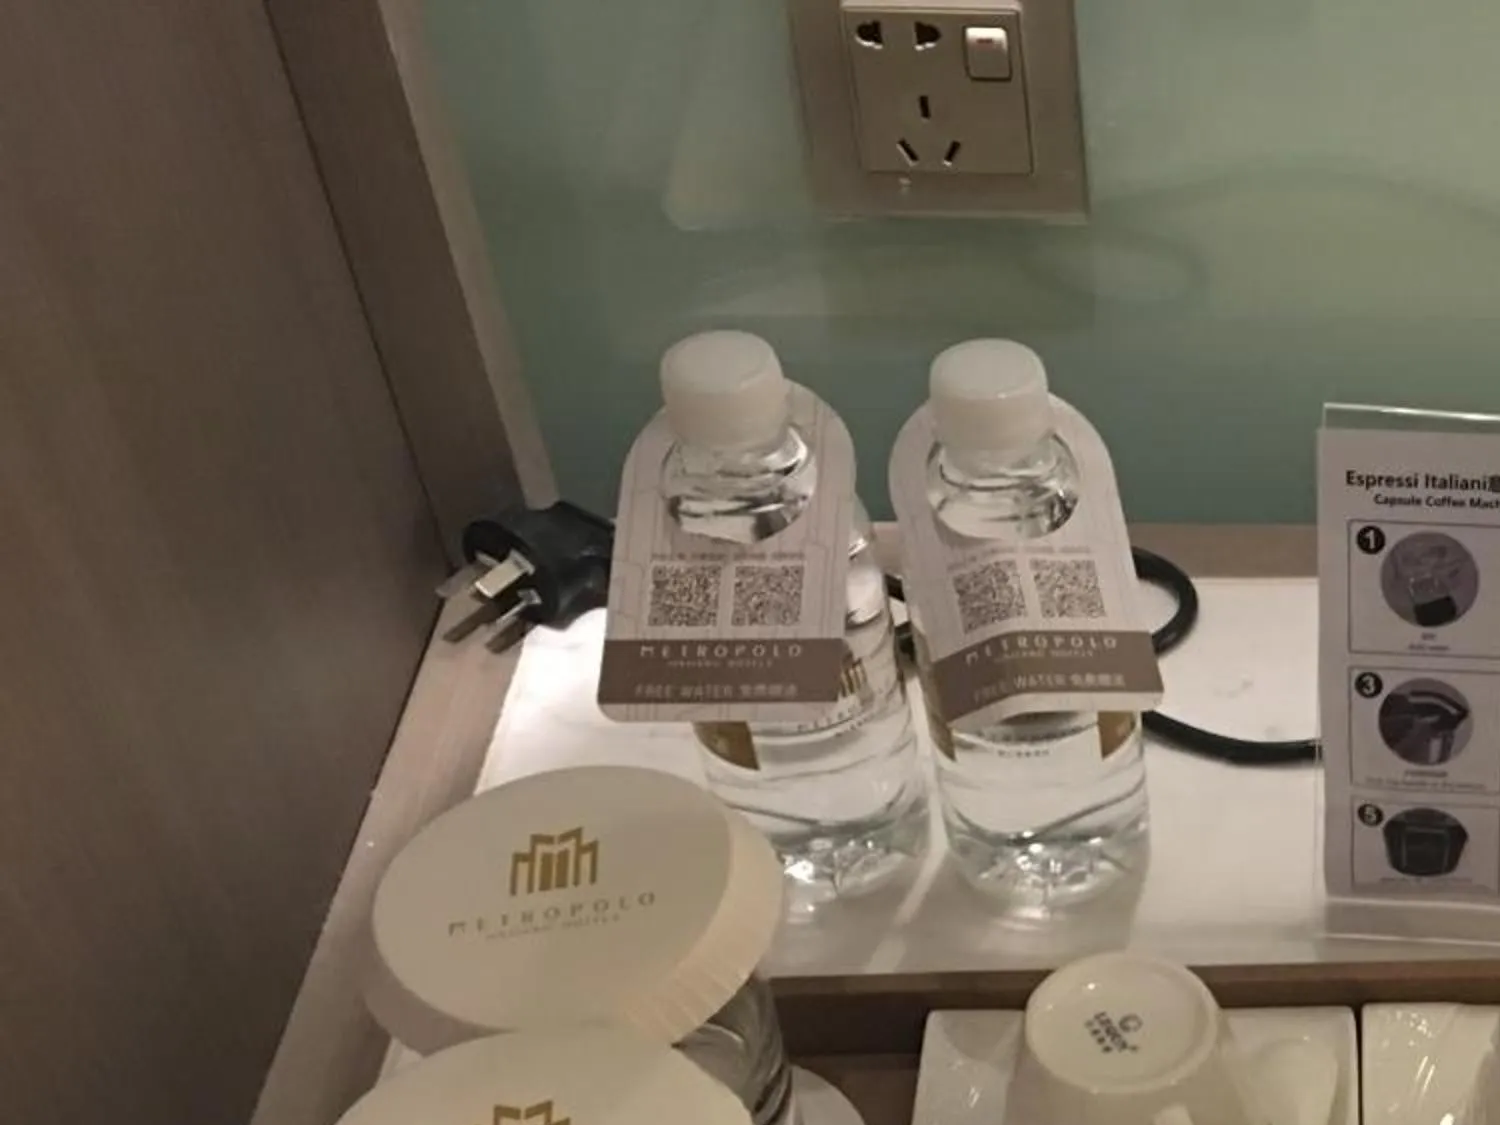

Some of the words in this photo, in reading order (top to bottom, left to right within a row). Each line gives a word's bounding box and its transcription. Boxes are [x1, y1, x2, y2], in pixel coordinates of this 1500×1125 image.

[1346, 470, 1419, 490] Espressi
[1425, 473, 1487, 490] Italiani
[1374, 493, 1421, 507] Capsule
[1425, 495, 1466, 507] Coffee
